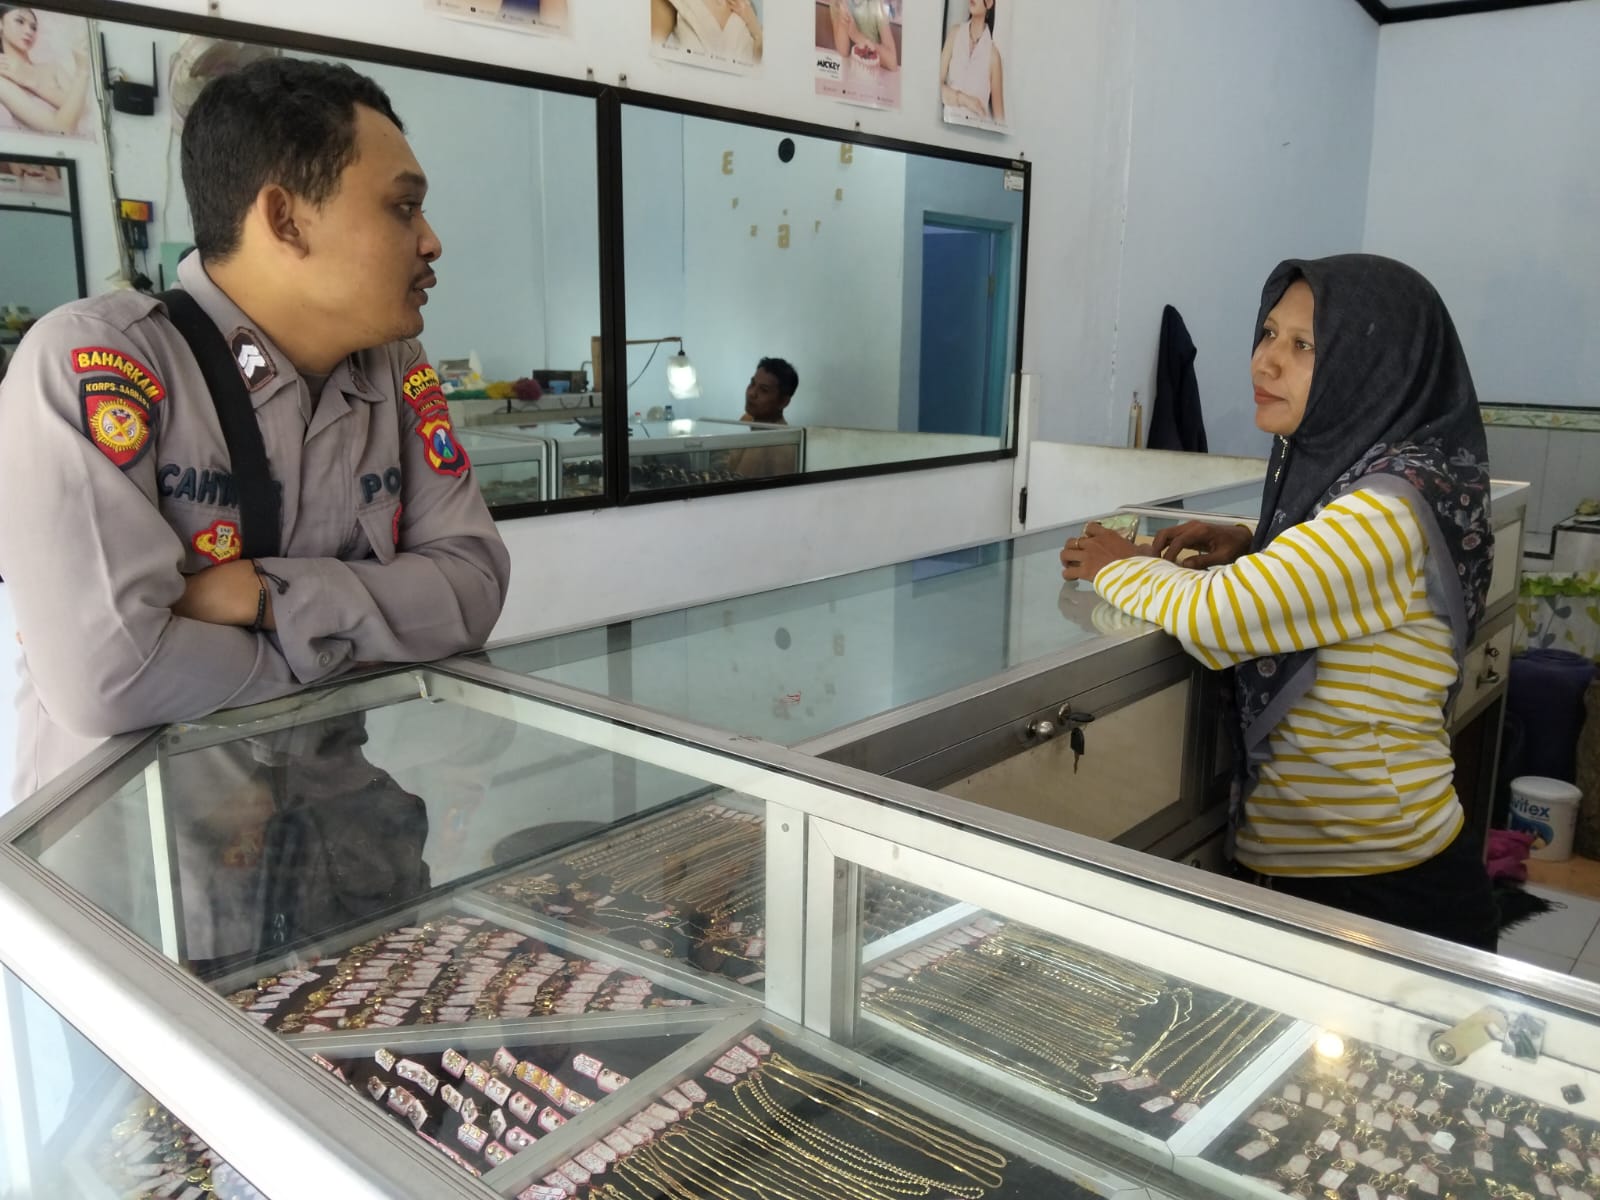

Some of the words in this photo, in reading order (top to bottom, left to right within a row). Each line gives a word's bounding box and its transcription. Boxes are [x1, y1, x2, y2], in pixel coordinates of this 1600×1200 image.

[816, 59, 841, 71] MICKEY
[78, 351, 159, 399] BAHARKAM
[85, 382, 116, 393] KORPS
[360, 467, 401, 504] PO
[1511, 797, 1550, 817] vitex
